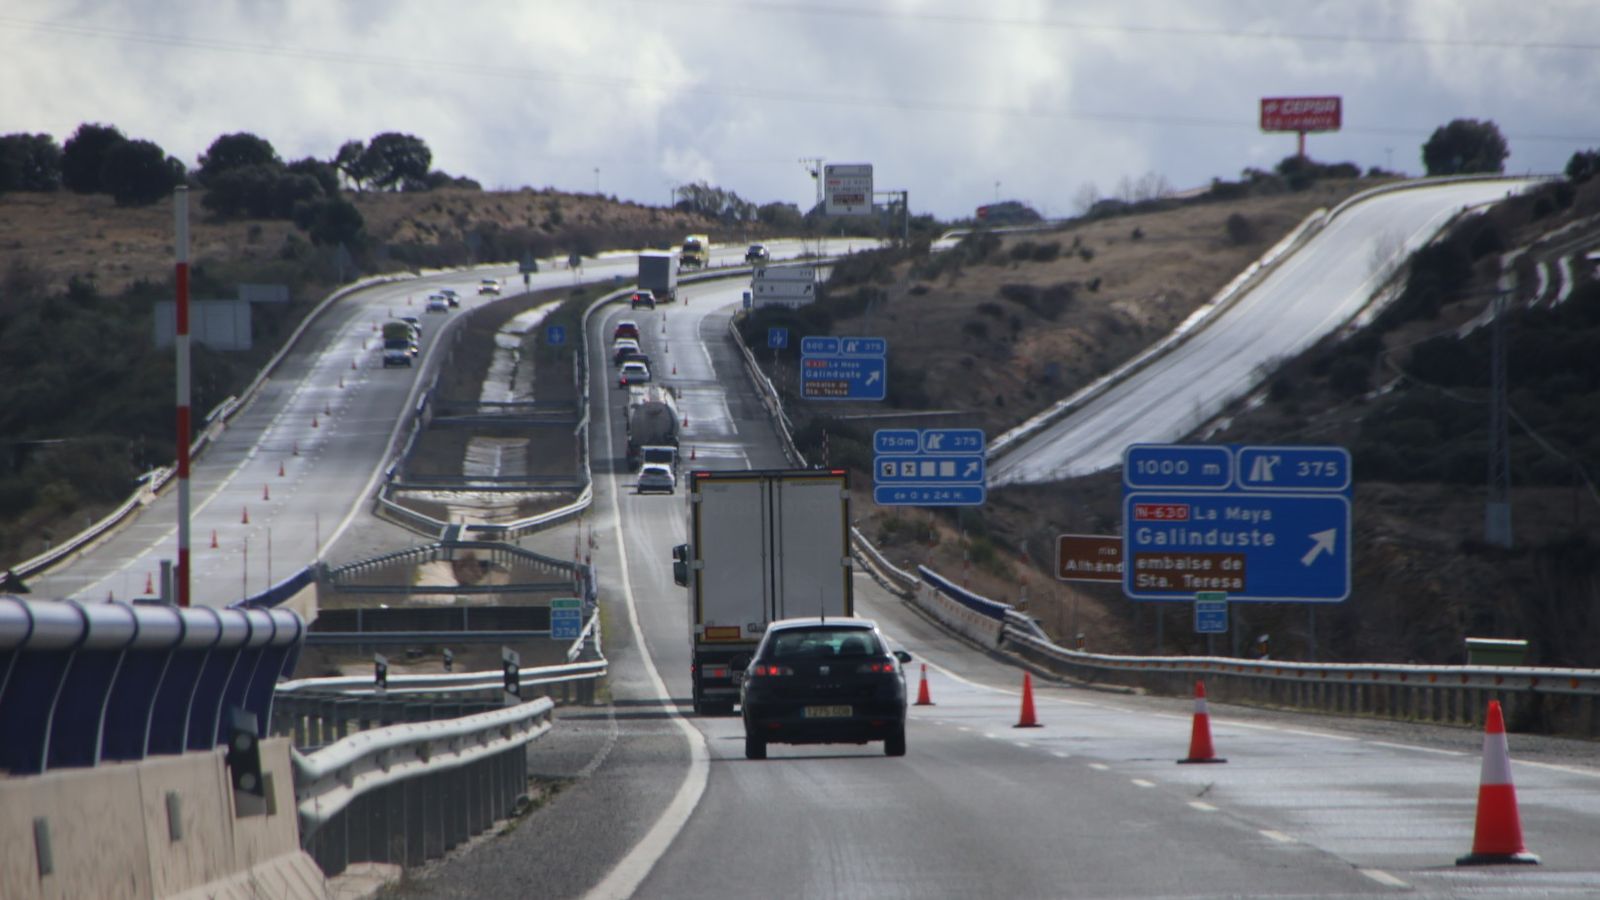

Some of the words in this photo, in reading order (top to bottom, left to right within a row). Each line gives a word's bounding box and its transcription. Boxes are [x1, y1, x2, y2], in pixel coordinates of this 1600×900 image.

[806, 369, 861, 379] Galinduste
[954, 437, 977, 447] 375
[1136, 460, 1189, 475] 1000
[1202, 463, 1220, 475] m
[1297, 461, 1339, 477] 375
[934, 491, 949, 500] 24
[1135, 506, 1187, 519] N-630
[1192, 507, 1217, 520] La
[1225, 507, 1272, 524] Maya
[1136, 527, 1276, 546] Galinduste
[1136, 556, 1212, 571] embalse
[1220, 557, 1243, 571] de
[1136, 573, 1173, 588] Sta.
[1182, 574, 1242, 589] Teresa
